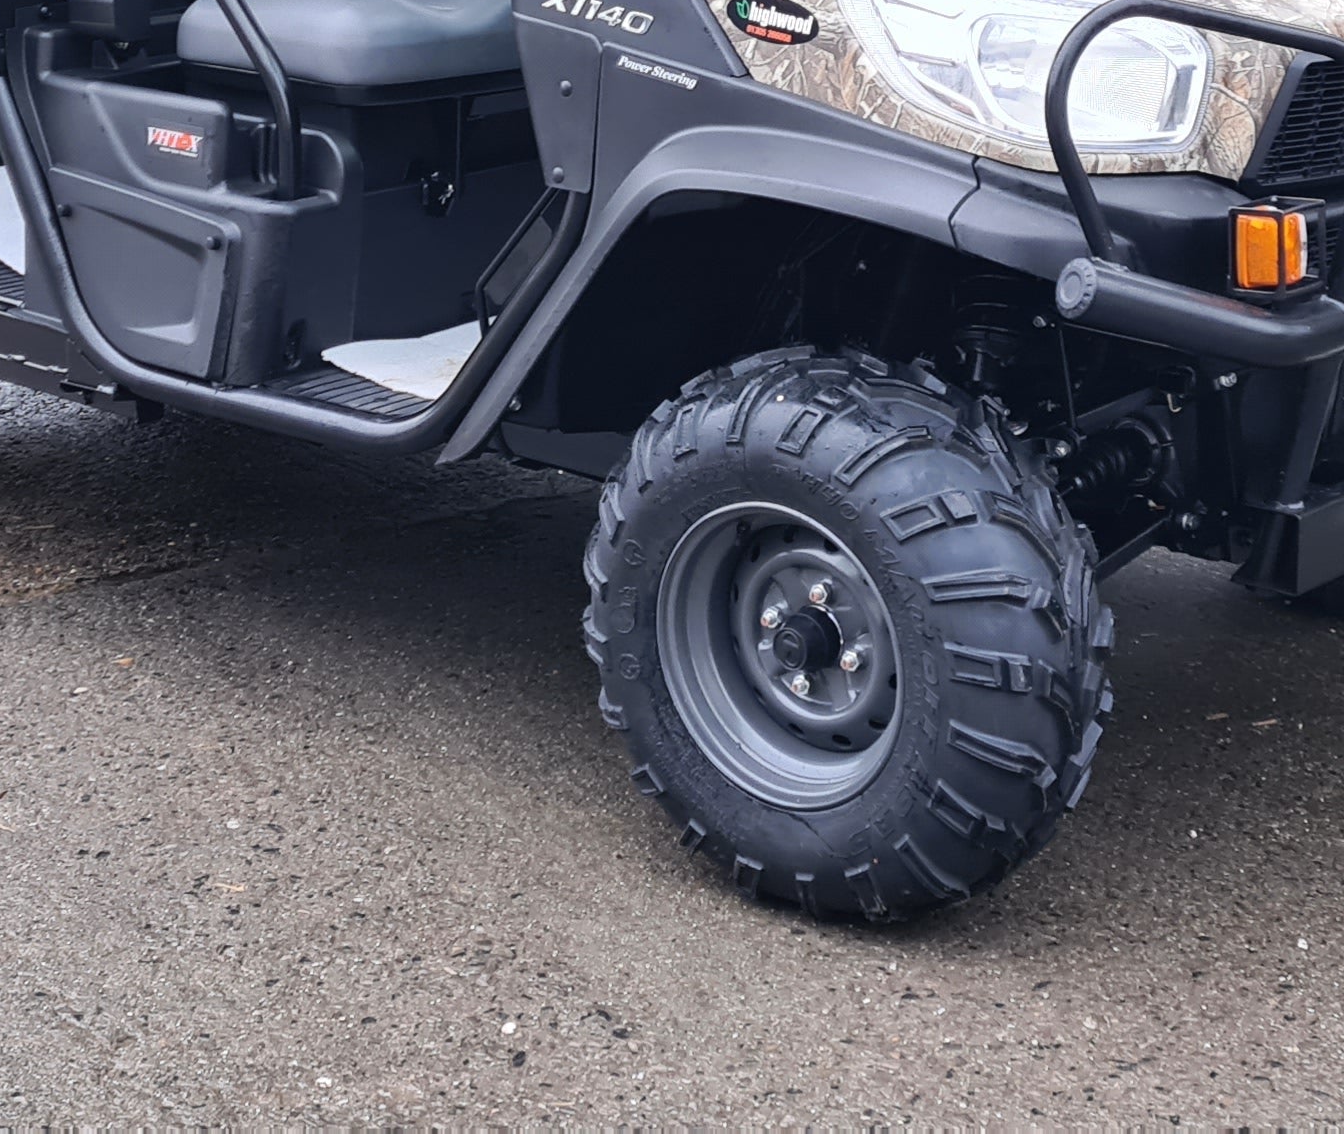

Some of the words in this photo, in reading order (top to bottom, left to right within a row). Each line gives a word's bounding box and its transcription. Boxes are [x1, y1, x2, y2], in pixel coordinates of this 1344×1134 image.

[748, 1, 814, 35] highwood
[617, 55, 653, 75] Power
[650, 66, 698, 91] Steering
